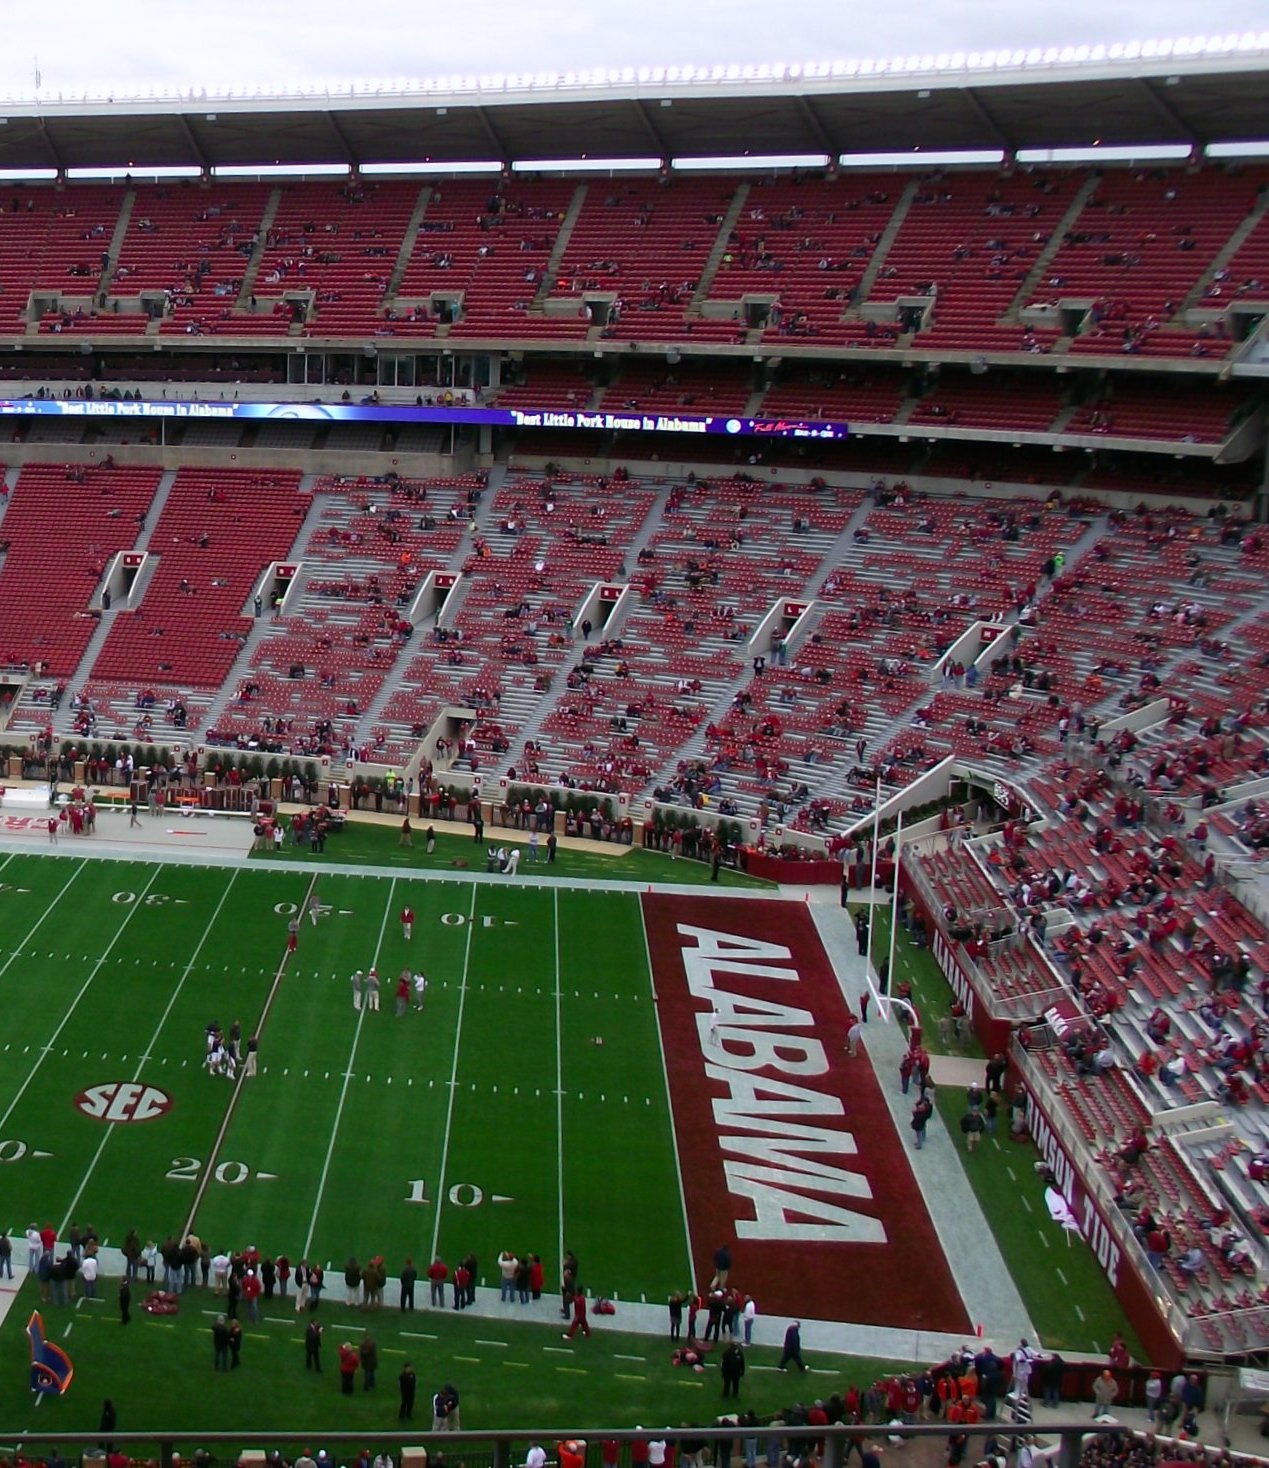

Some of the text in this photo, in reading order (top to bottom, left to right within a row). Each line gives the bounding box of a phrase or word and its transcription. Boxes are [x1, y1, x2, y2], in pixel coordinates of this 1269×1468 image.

[543, 413, 574, 426] Little
[576, 414, 603, 428] Pork
[606, 415, 640, 429] House
[111, 891, 171, 905] 30
[676, 923, 887, 1243] ALABAMA
[79, 1083, 168, 1120] SEC
[165, 1157, 250, 1184] 20
[404, 1179, 484, 1206] 10
[1020, 1081, 1120, 1288] RIMSON TIDE
